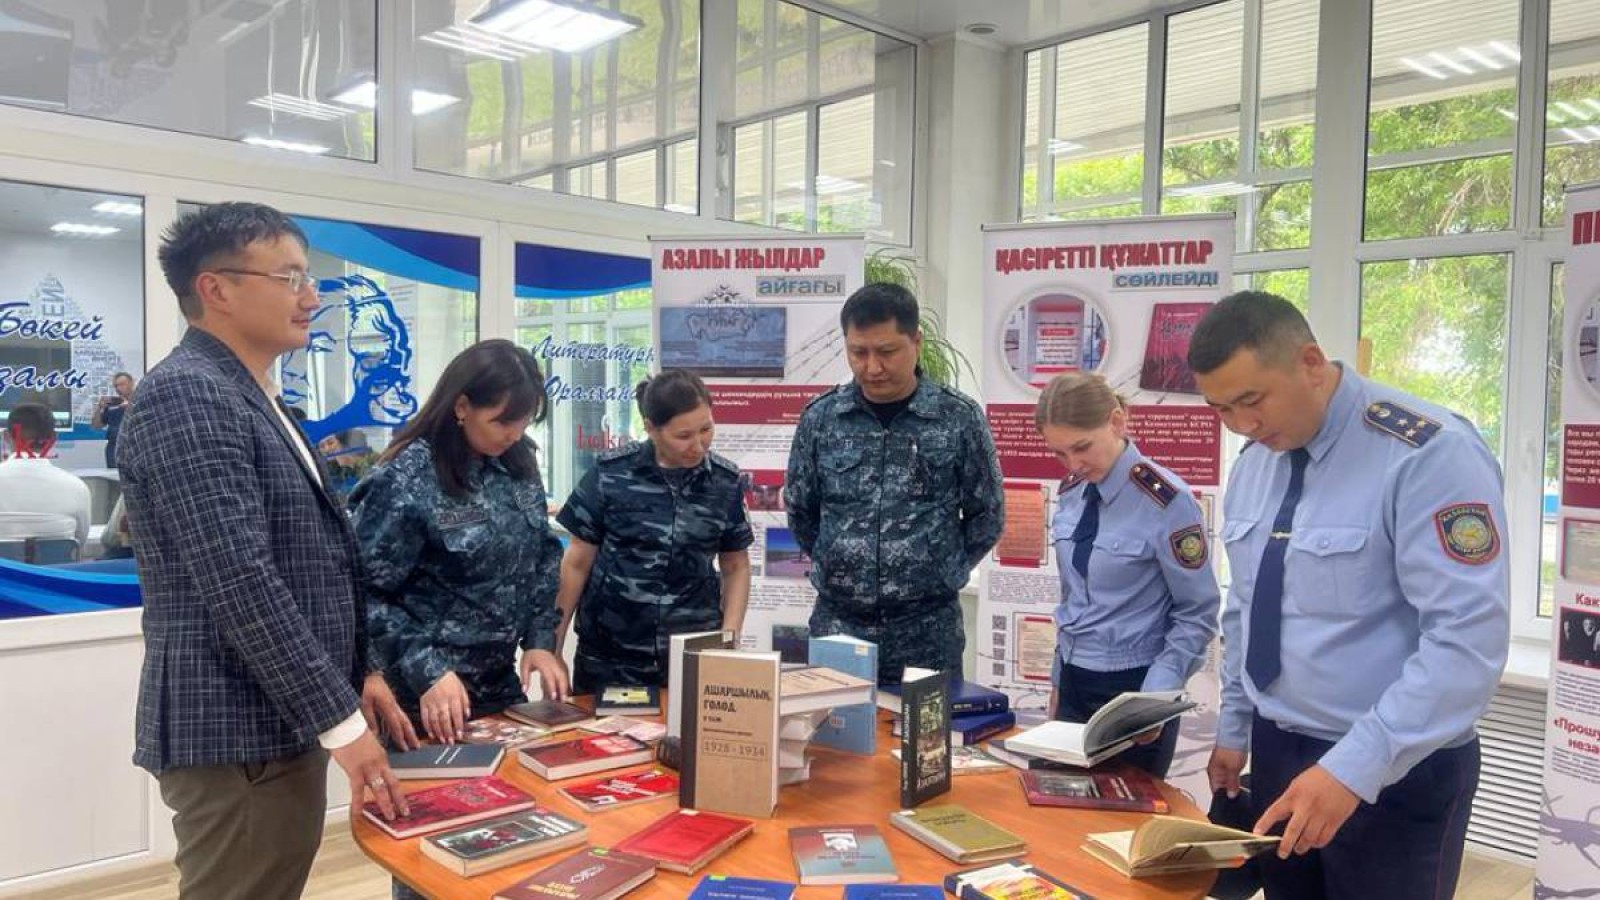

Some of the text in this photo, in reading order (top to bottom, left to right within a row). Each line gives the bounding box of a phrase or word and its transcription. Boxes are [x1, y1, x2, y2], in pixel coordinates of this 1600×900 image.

[662, 247, 825, 272] АЗАЛЫ ЖЫЛДАР
[996, 240, 1213, 275] ҚАСІРЕТТІ ҚҰЖАТТАР
[759, 277, 841, 295] айғағы
[703, 699, 736, 713] ГОЛОД
